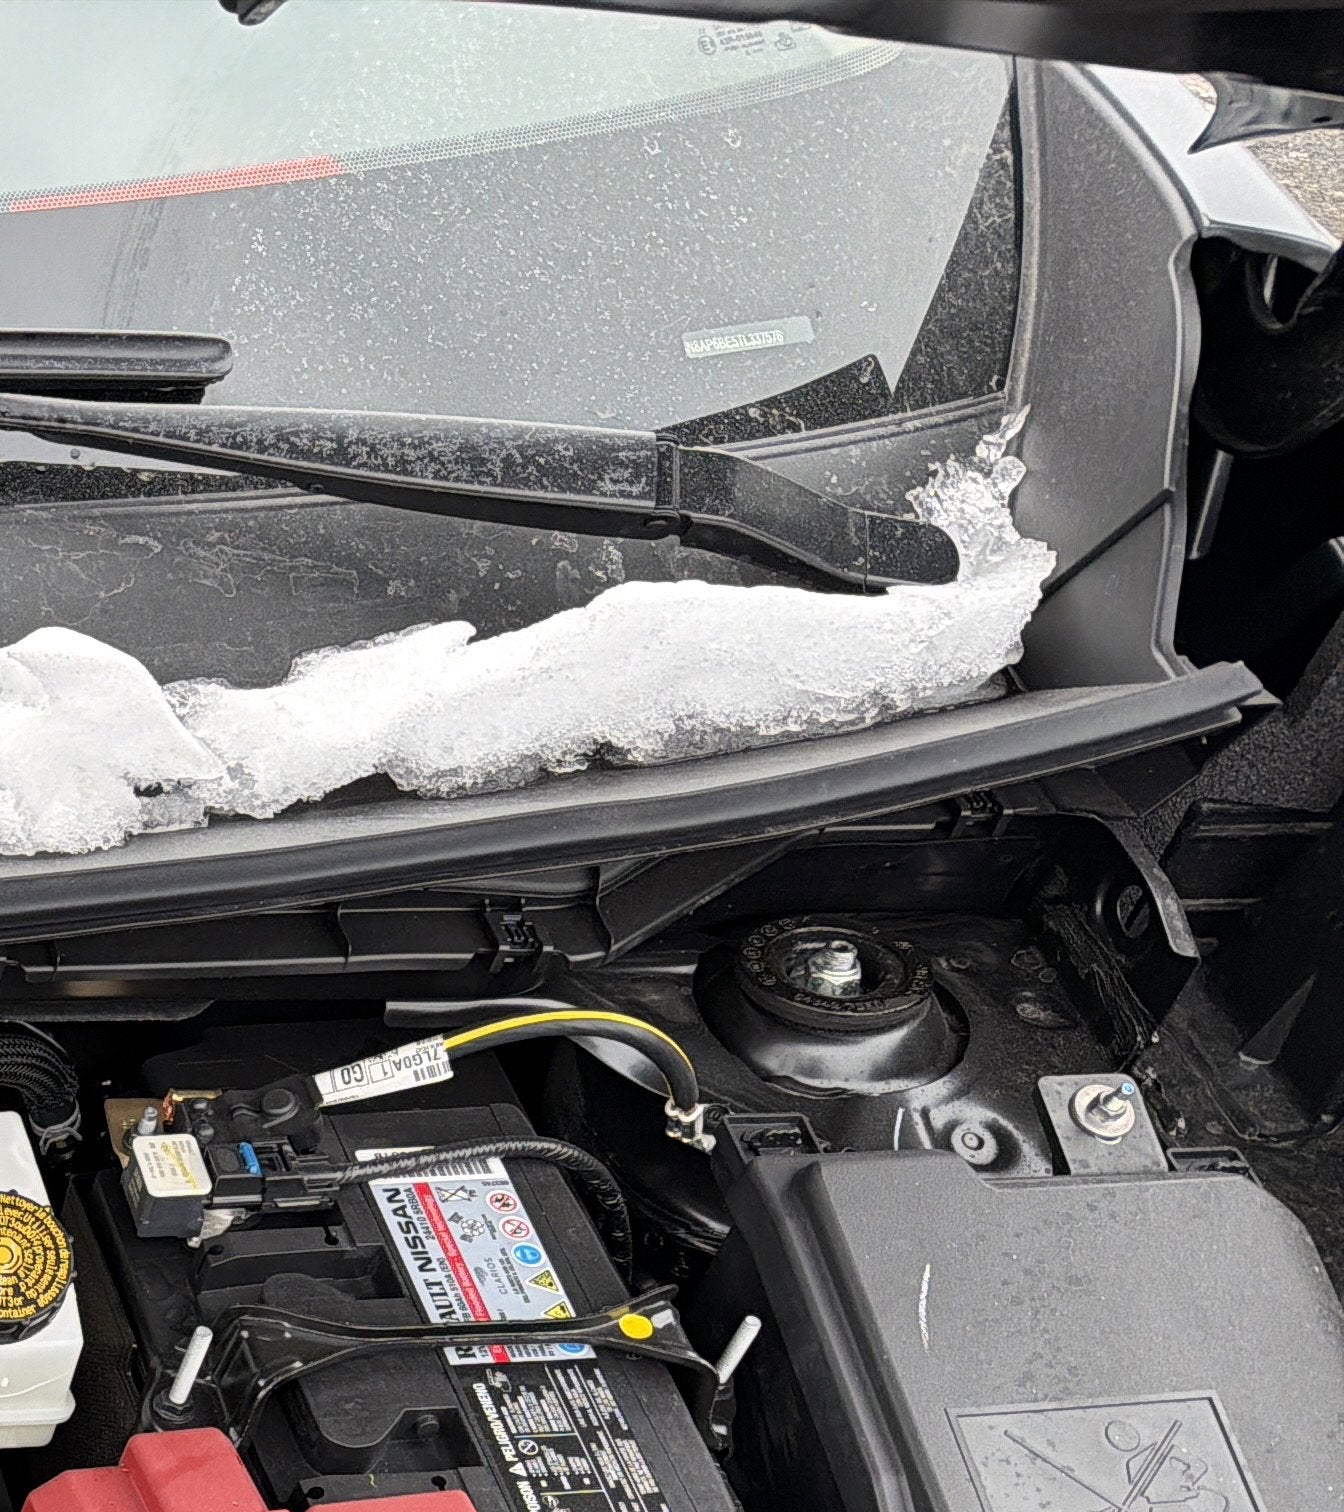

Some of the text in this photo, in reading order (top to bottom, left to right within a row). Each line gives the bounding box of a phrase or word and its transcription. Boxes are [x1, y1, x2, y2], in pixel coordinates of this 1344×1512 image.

[381, 1187, 437, 1272] NISSAN
[482, 1257, 509, 1294] CLARIOS
[422, 1278, 477, 1359] RAULT
[471, 1382, 520, 1461] PELIGRO/VENENO
